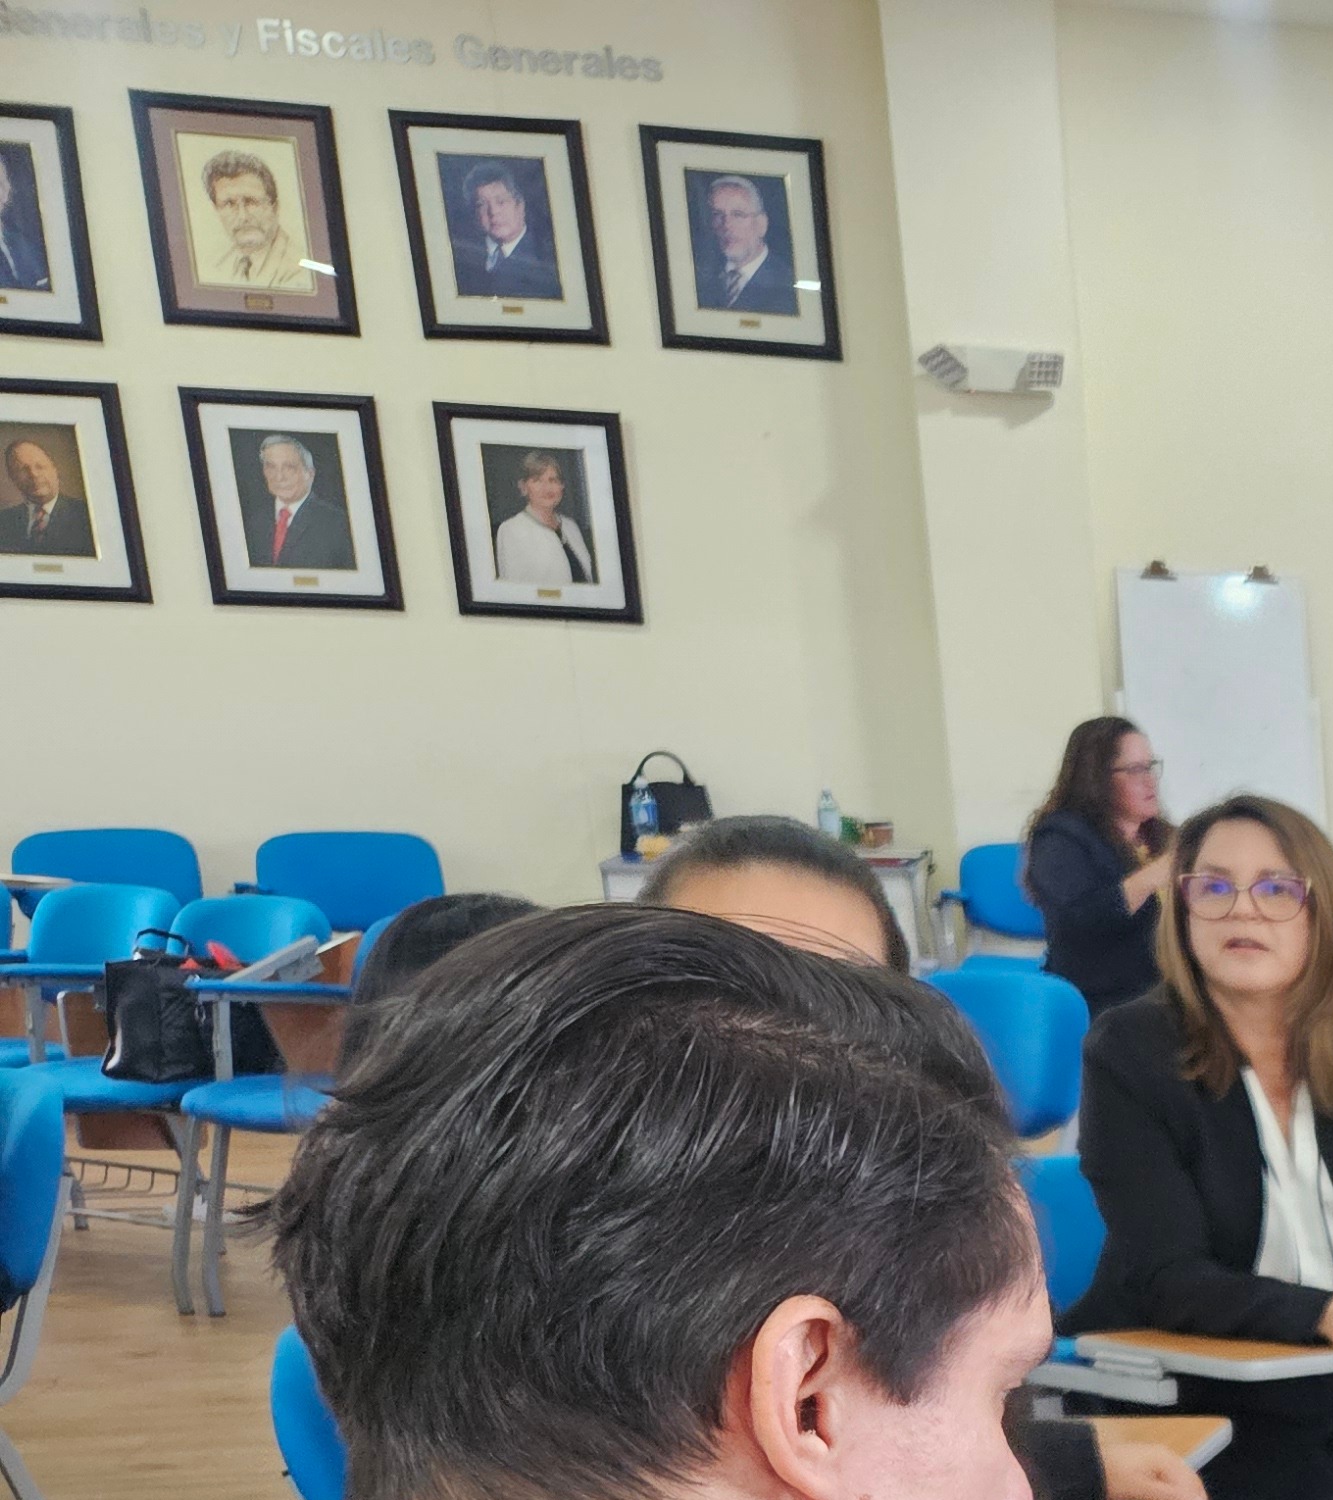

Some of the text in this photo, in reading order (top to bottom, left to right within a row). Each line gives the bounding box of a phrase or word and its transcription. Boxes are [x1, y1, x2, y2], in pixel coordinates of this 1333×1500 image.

[218, 22, 243, 58] y
[256, 18, 436, 66] Fiscales
[453, 33, 664, 82] Generales
